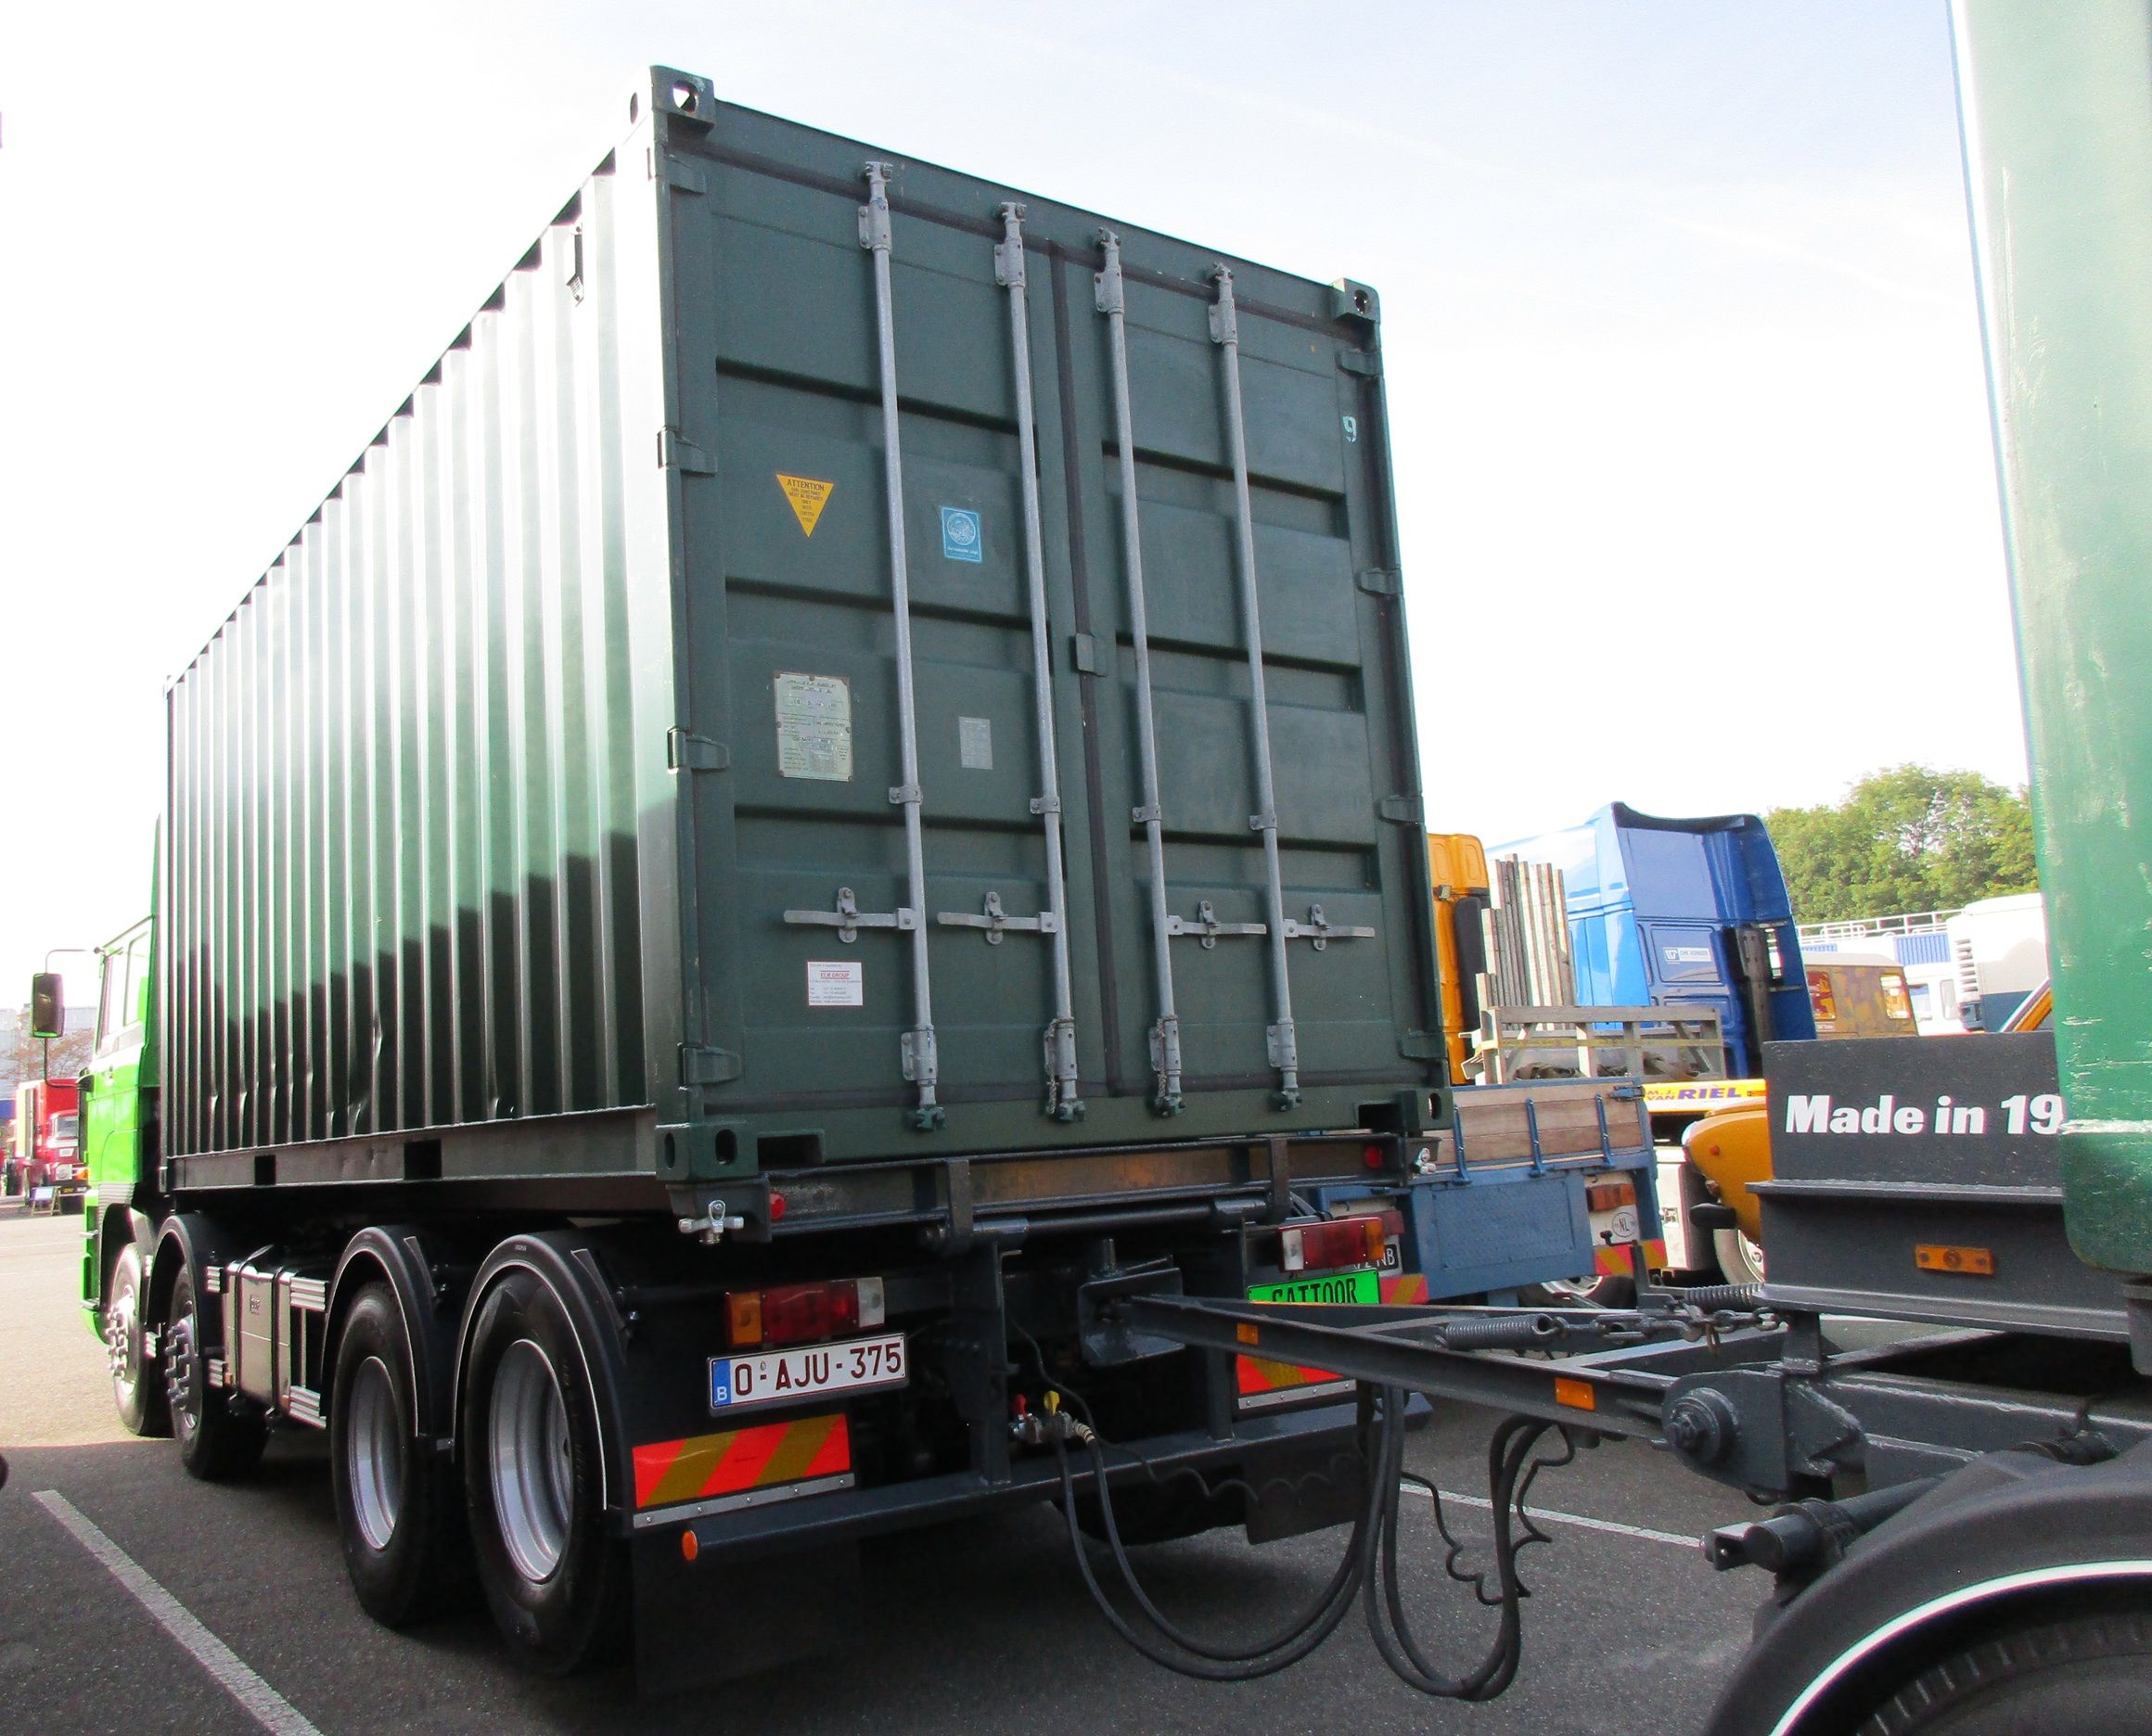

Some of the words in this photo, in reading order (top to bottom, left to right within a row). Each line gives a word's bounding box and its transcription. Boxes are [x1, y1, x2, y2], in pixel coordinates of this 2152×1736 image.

[787, 479, 825, 491] ATTENTION
[1677, 1088, 1741, 1099] RIEL
[1786, 1094, 1926, 1135] Made
[1935, 1095, 1986, 1135] in
[1619, 1218, 1630, 1232] NL
[716, 1385, 728, 1401] B
